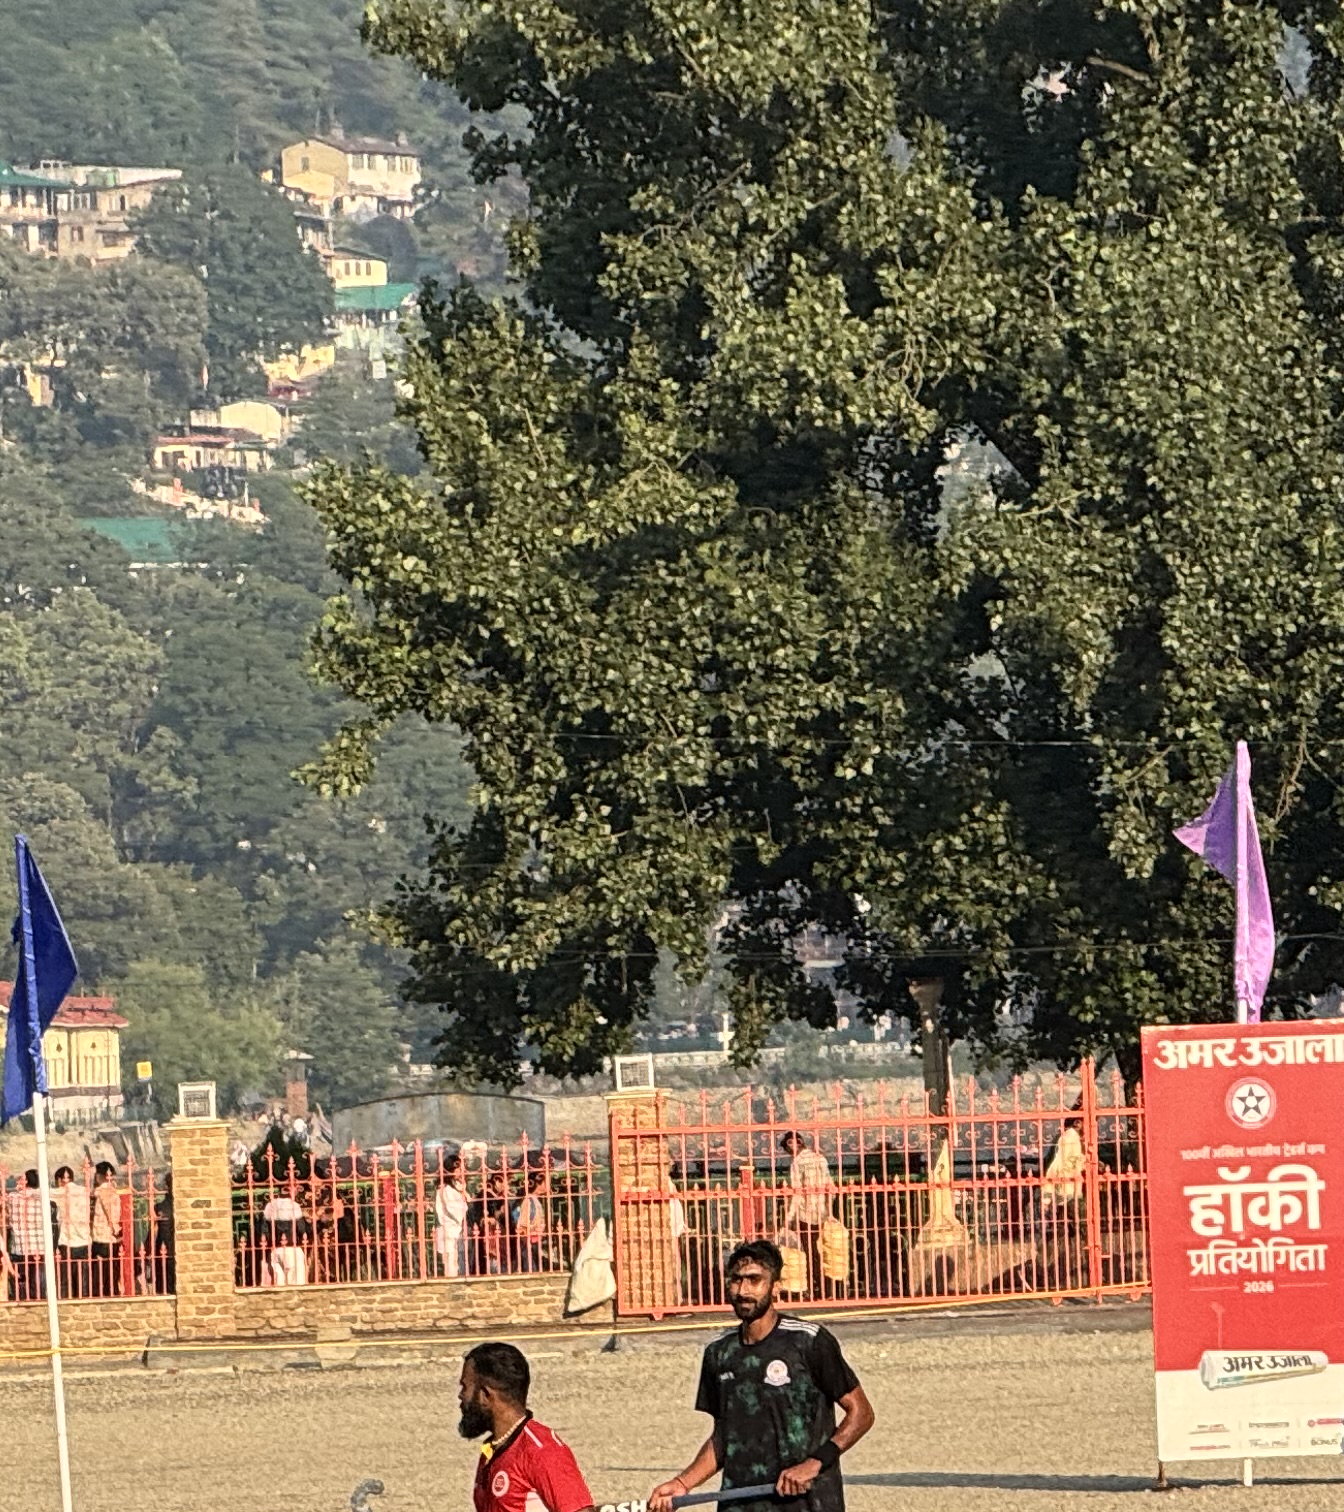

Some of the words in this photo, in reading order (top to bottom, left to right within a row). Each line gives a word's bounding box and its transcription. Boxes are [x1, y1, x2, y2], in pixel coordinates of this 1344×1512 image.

[1153, 1038, 1237, 1069] अमर
[1238, 1033, 1344, 1066] उजाला
[1183, 1163, 1326, 1237] हॉकी
[1187, 1237, 1328, 1276] प्रतियोगिता
[1223, 1356, 1265, 1373] अमर
